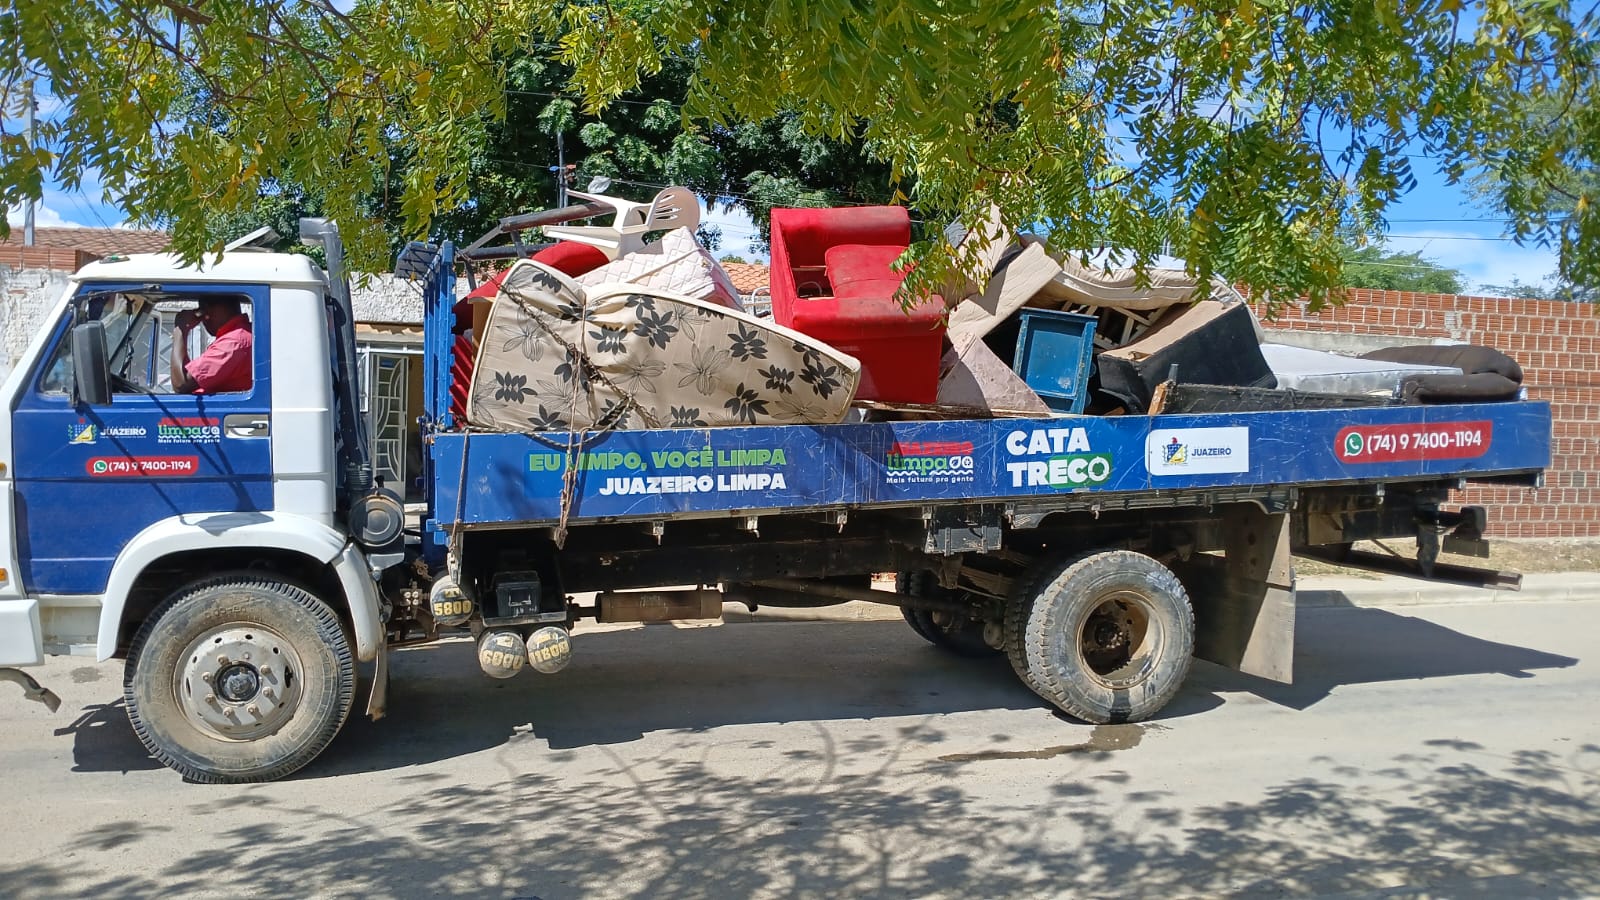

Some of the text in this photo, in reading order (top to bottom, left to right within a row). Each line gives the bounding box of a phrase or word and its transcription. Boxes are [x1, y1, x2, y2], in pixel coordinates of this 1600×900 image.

[100, 427, 147, 436] JUAZEIRO
[1006, 427, 1091, 456] CATA
[1366, 430, 1482, 455] (74) 9 7400-1194
[529, 453, 561, 471] EU
[651, 446, 714, 468] VOCÊ
[717, 449, 787, 467] LIMPA
[1191, 447, 1232, 457] JUAZEIRO
[108, 461, 191, 472] (74) 9 7400-1194
[1006, 455, 1111, 488] TRECO
[599, 473, 787, 495] JUAZEIRO LIMPA
[951, 475, 974, 483] gente
[434, 600, 472, 616] 5800
